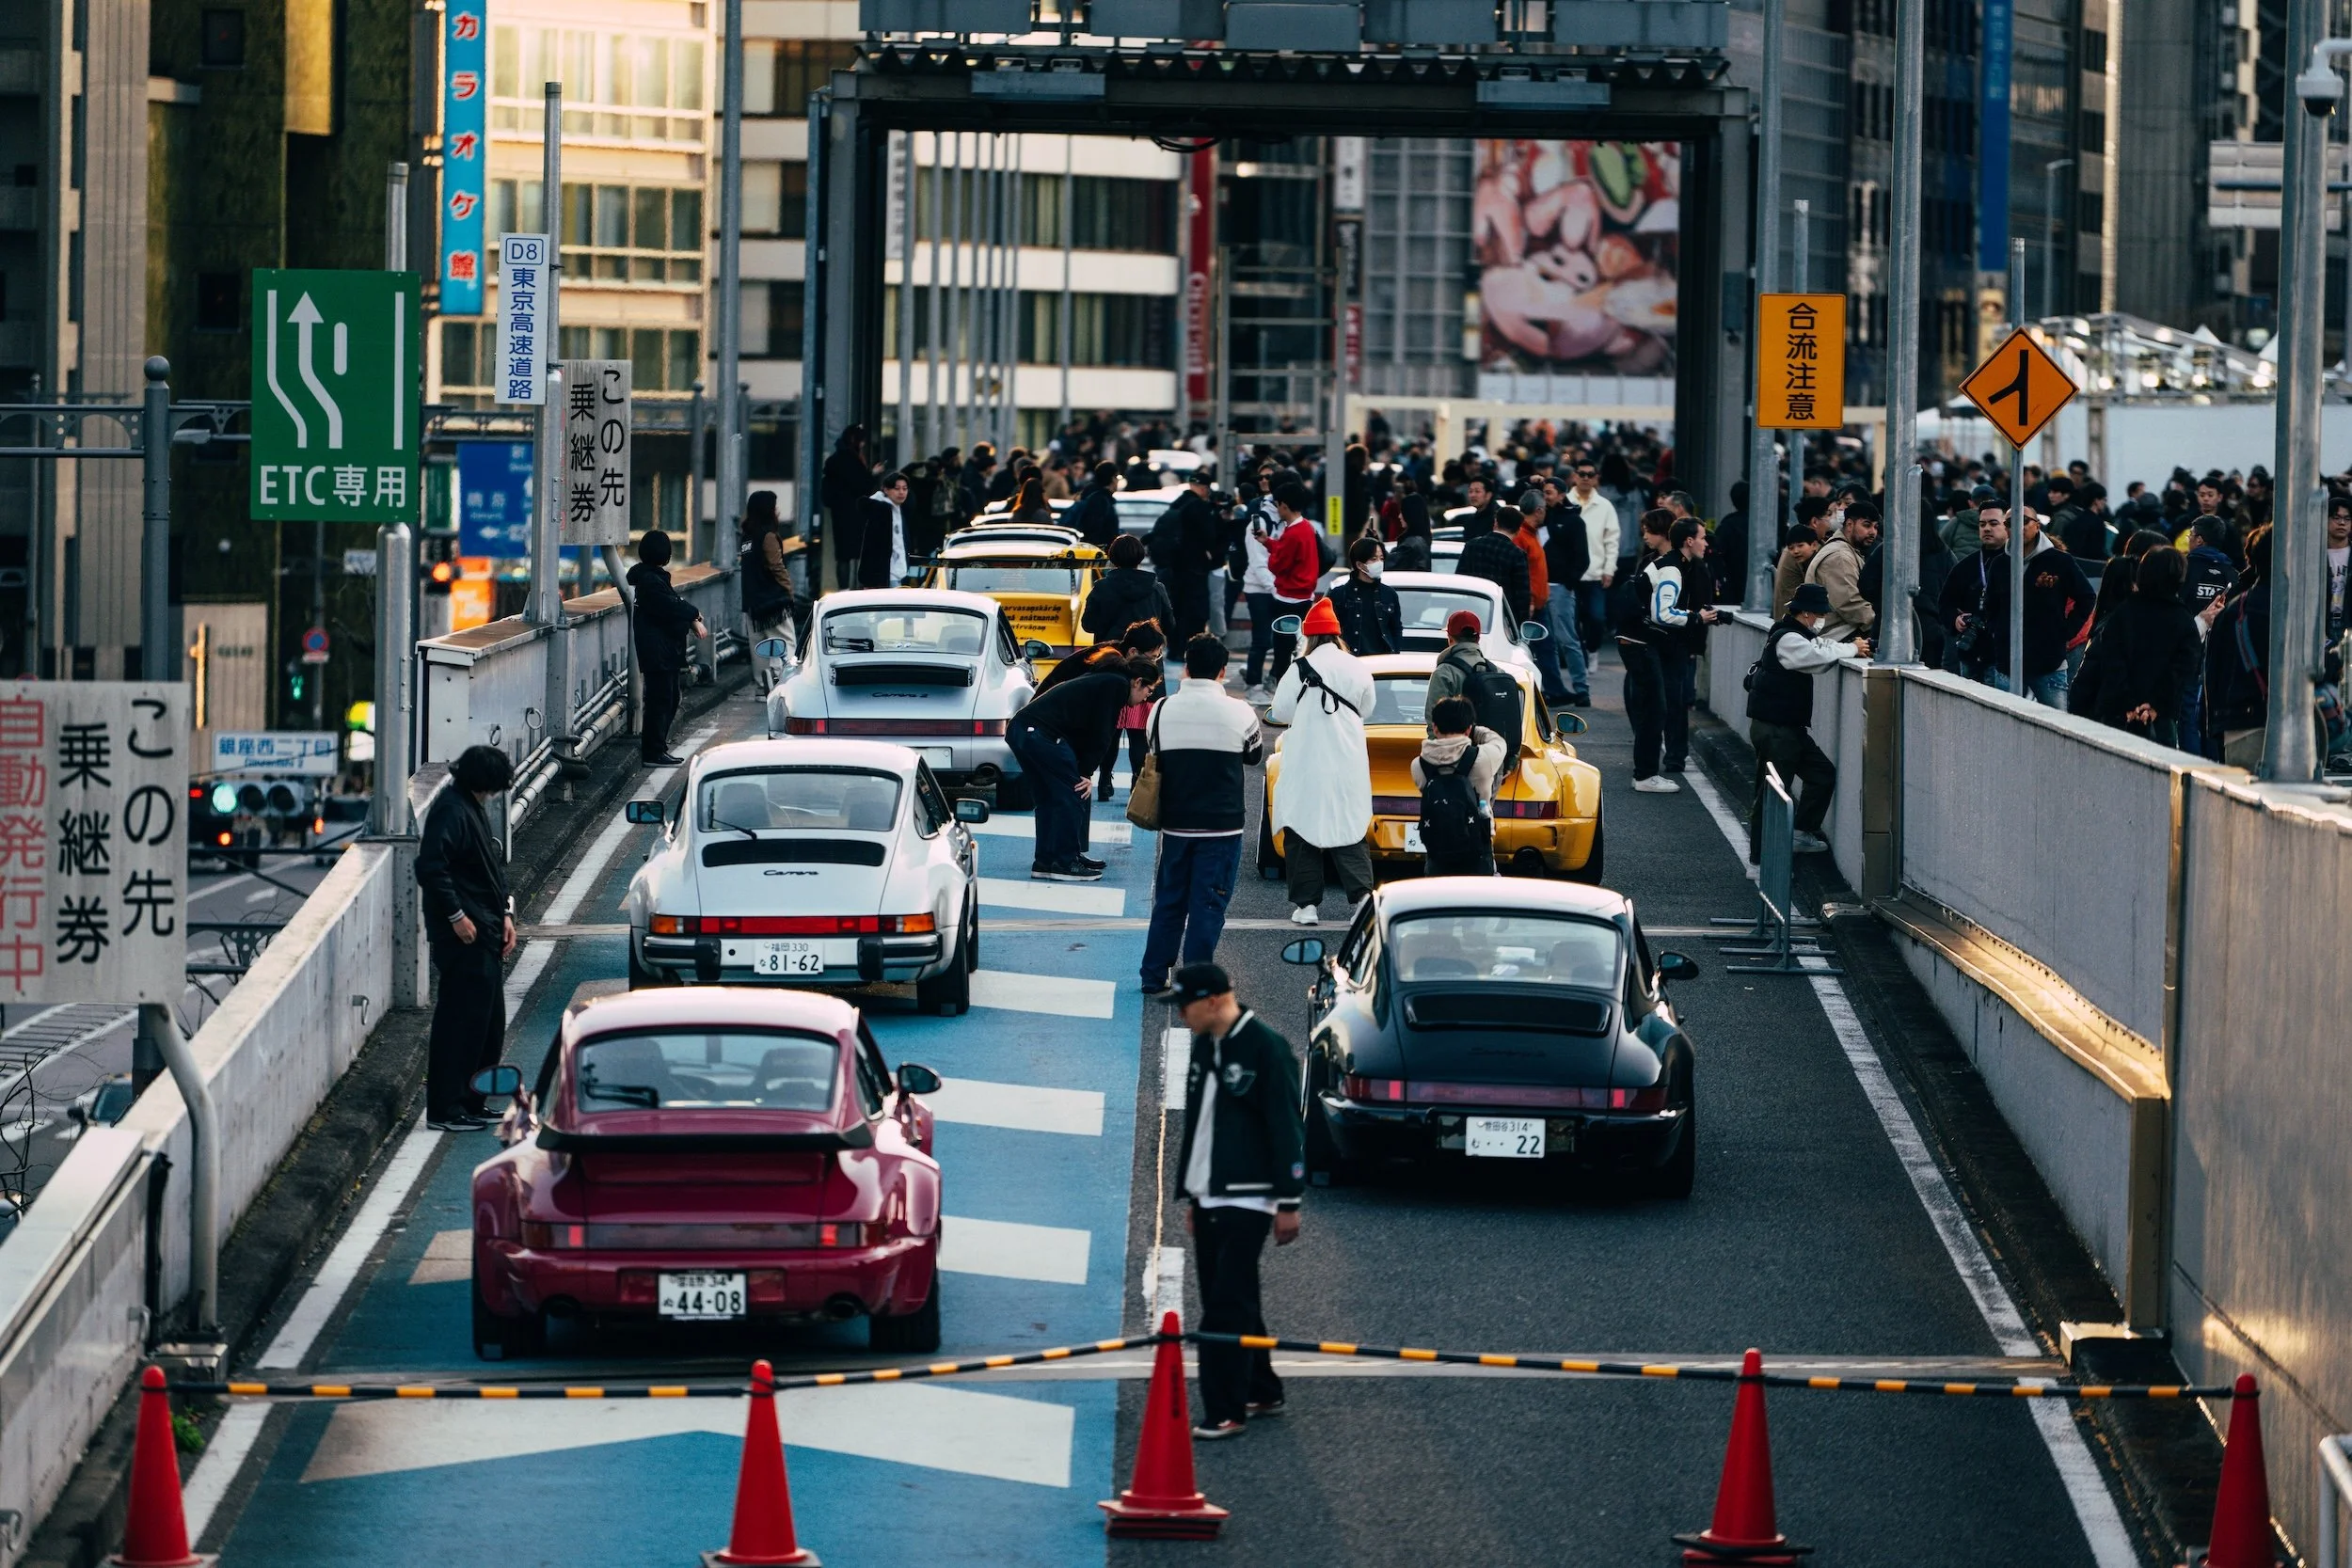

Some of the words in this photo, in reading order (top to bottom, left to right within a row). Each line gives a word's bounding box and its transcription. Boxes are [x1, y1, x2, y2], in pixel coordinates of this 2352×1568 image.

[511, 243, 538, 261] D8
[508, 267, 536, 400] 東京高速道路
[1786, 302, 1818, 420] 合流注意
[260, 464, 406, 508] ETC専用
[570, 383, 596, 522] 乗継券
[600, 370, 625, 507] この先
[2197, 586, 2221, 596] STA
[0, 694, 45, 991] 自動発行中
[56, 722, 111, 964] 乗継券
[123, 699, 174, 937] この先
[770, 955, 819, 971] 81-62
[677, 1291, 741, 1313] 44-08
